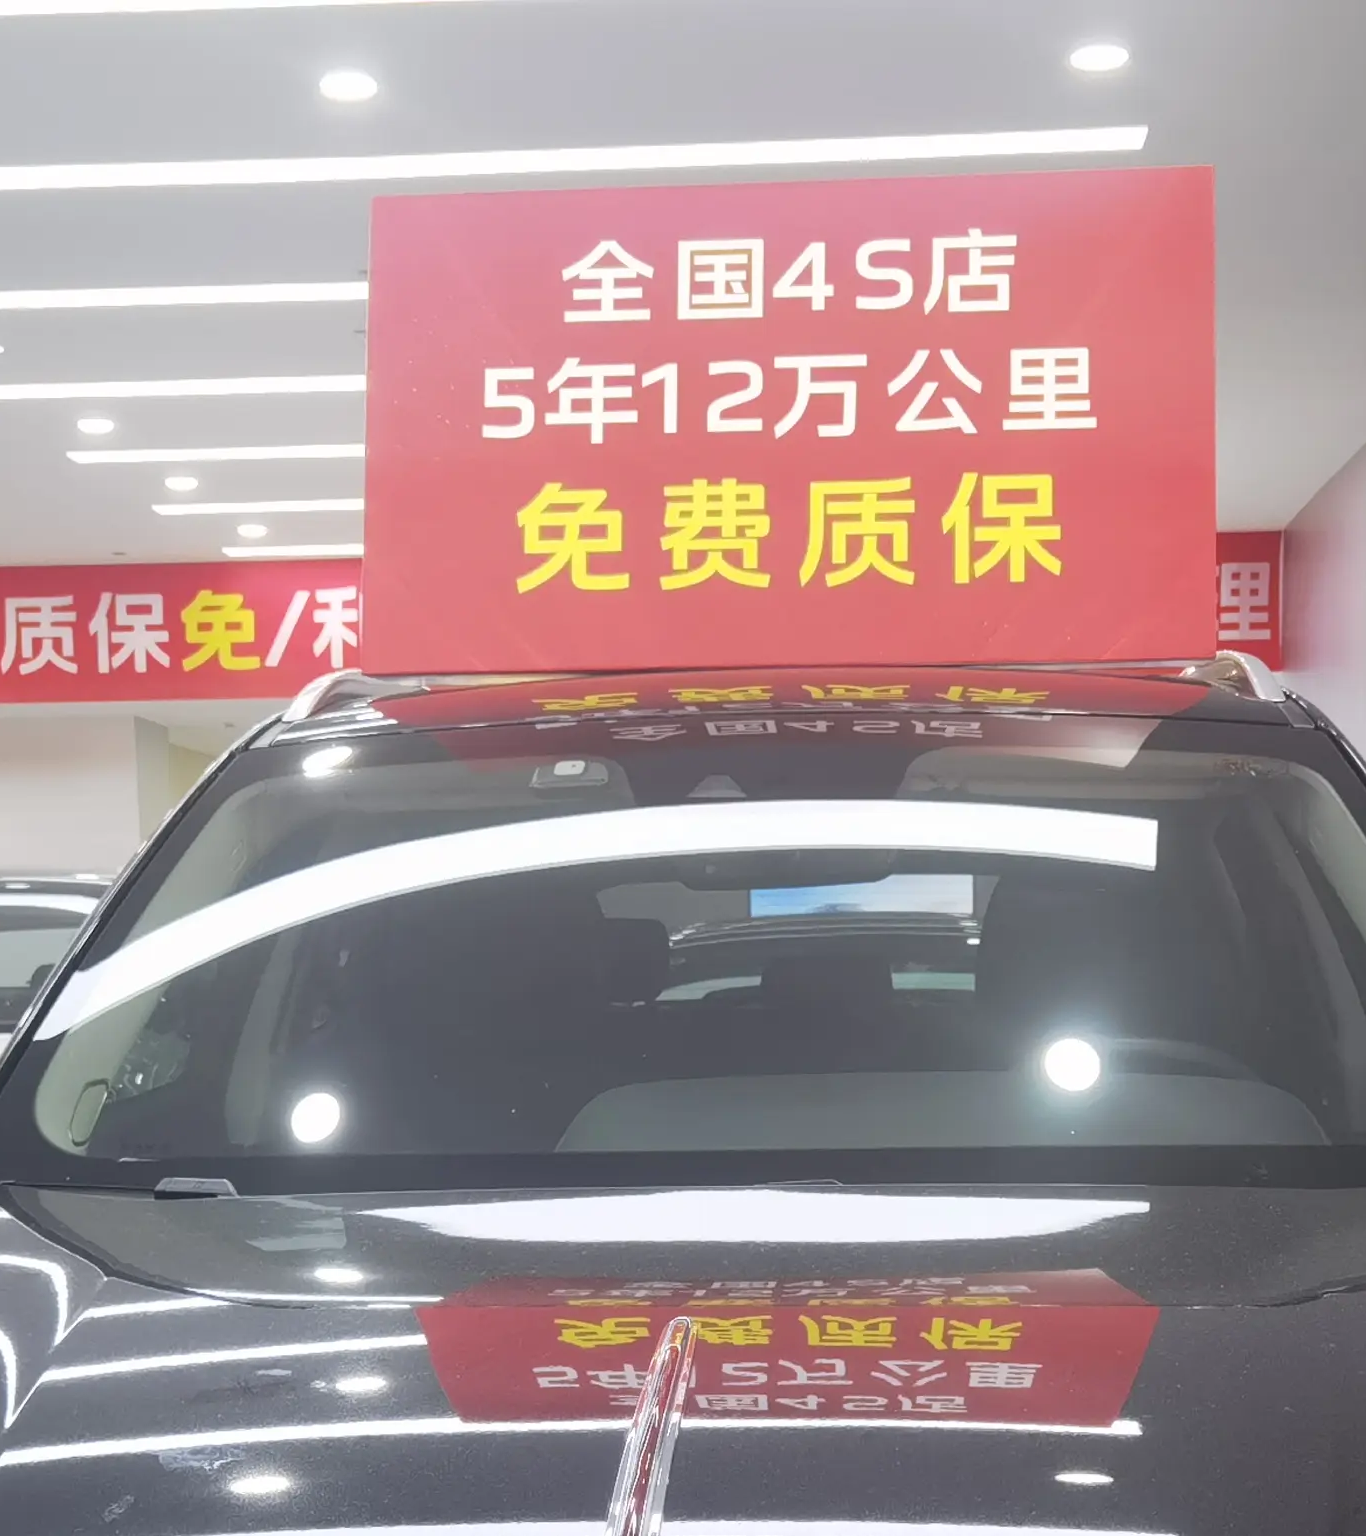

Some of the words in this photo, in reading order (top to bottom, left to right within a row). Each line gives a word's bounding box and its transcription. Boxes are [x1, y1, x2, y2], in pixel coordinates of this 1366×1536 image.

[561, 228, 1018, 323] 全国4S店
[482, 347, 1098, 445] 5年12万公里
[515, 472, 1063, 595] 免费质保
